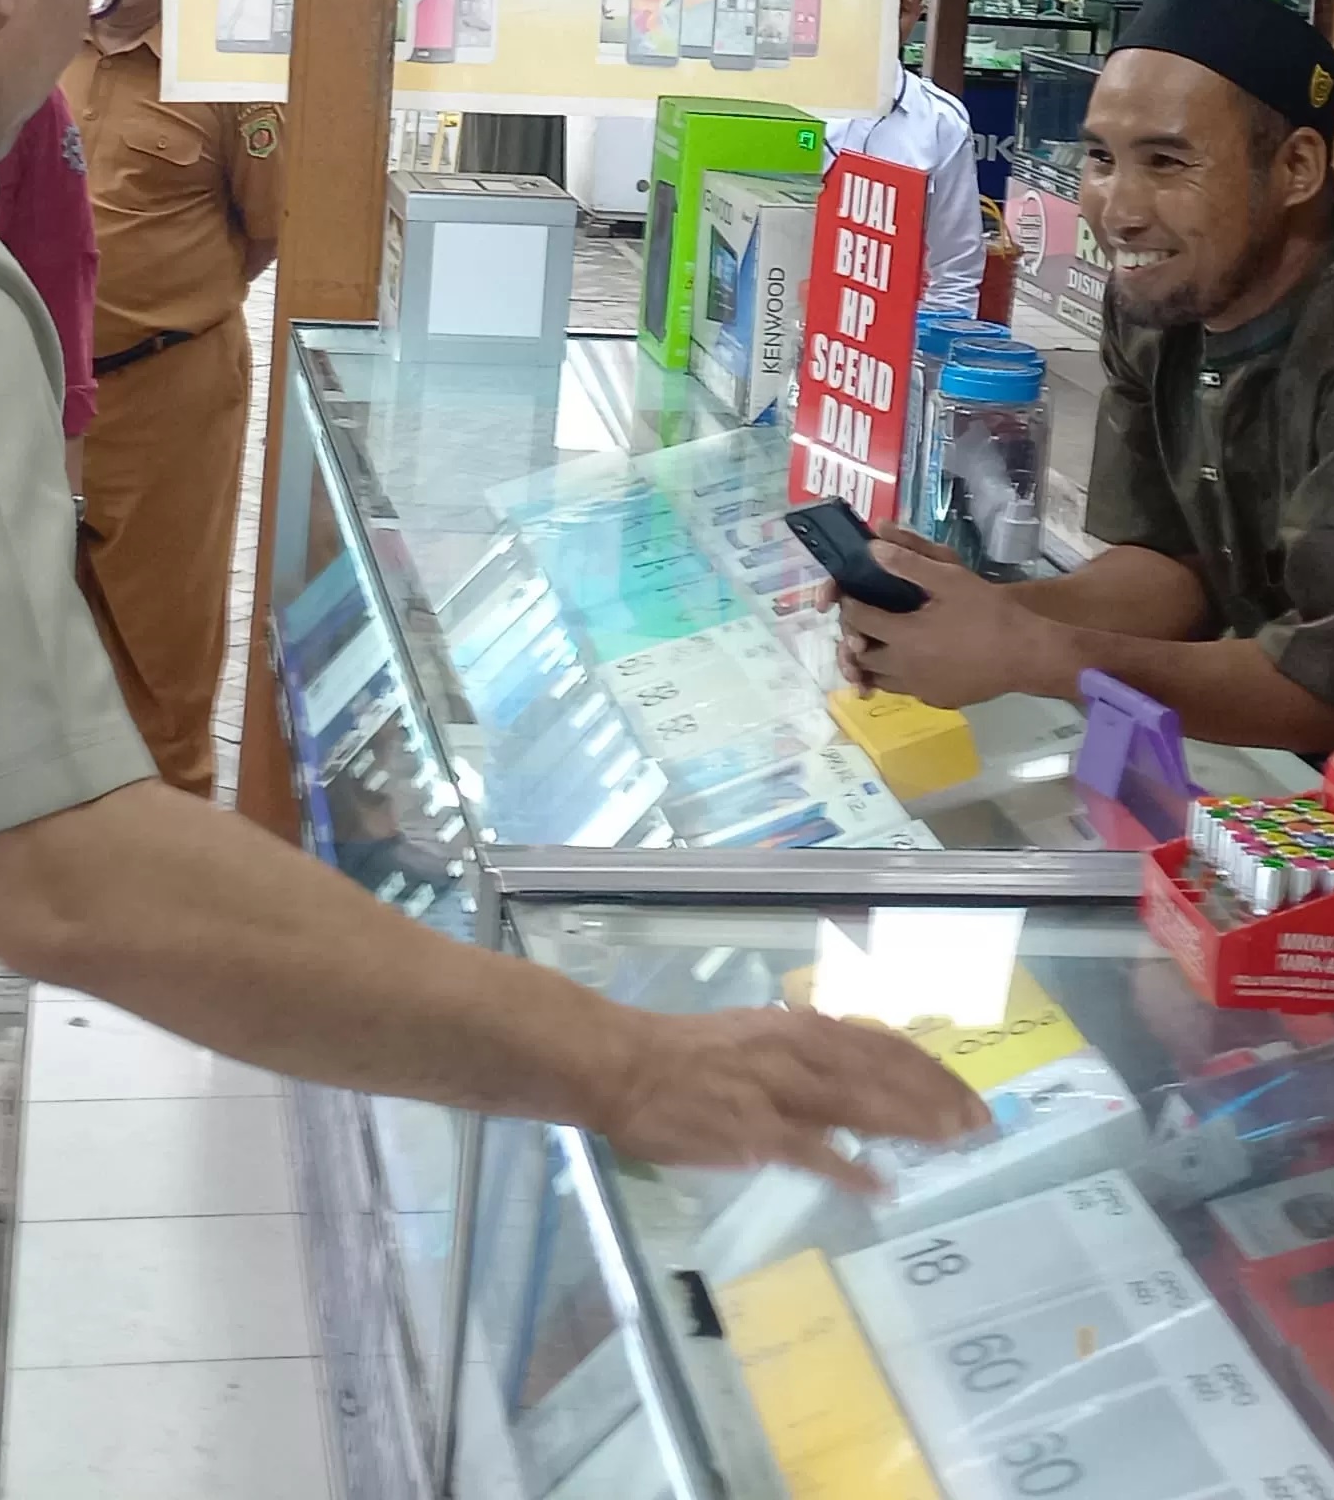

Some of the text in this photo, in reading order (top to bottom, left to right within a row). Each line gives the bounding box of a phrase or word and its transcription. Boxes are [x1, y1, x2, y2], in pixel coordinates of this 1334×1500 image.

[838, 171, 900, 237] JUAL
[832, 225, 893, 293] BELI
[761, 266, 786, 377] KENWOOD
[839, 285, 876, 343] HP
[809, 335, 895, 413] SCEND
[819, 395, 873, 465] DAN
[804, 451, 877, 525] BARU
